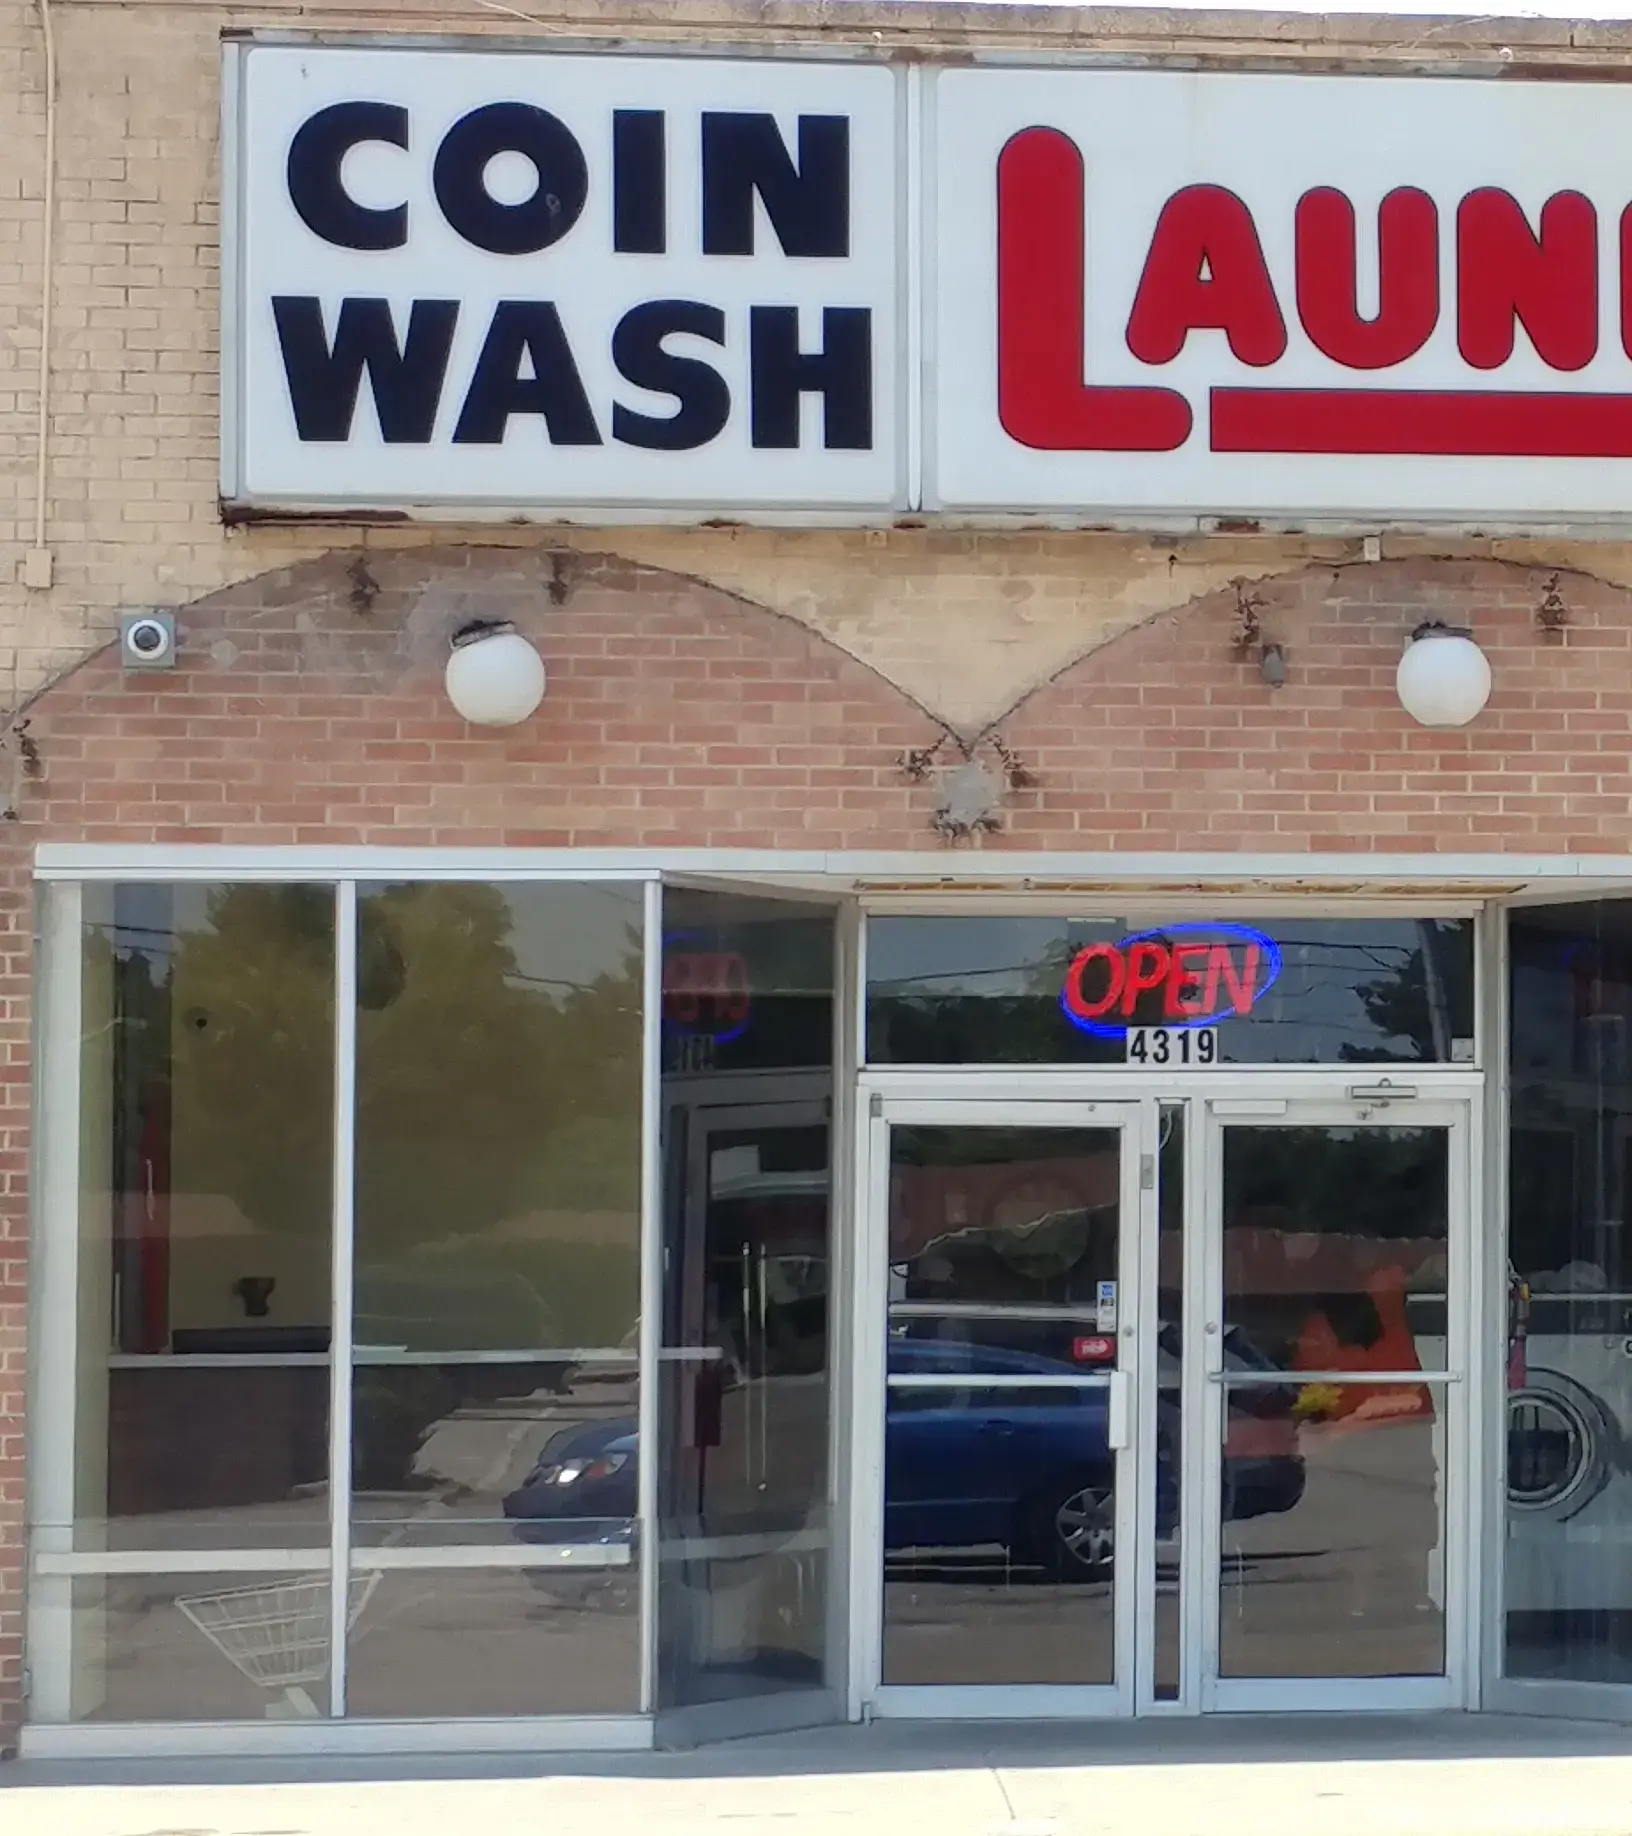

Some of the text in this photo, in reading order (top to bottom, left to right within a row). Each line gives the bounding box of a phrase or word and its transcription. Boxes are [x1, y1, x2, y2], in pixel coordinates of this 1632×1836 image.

[286, 100, 851, 258] COIN
[271, 295, 873, 451] WASH
[1065, 942, 1260, 1018] OPEN
[1130, 1029, 1214, 1064] 4319
